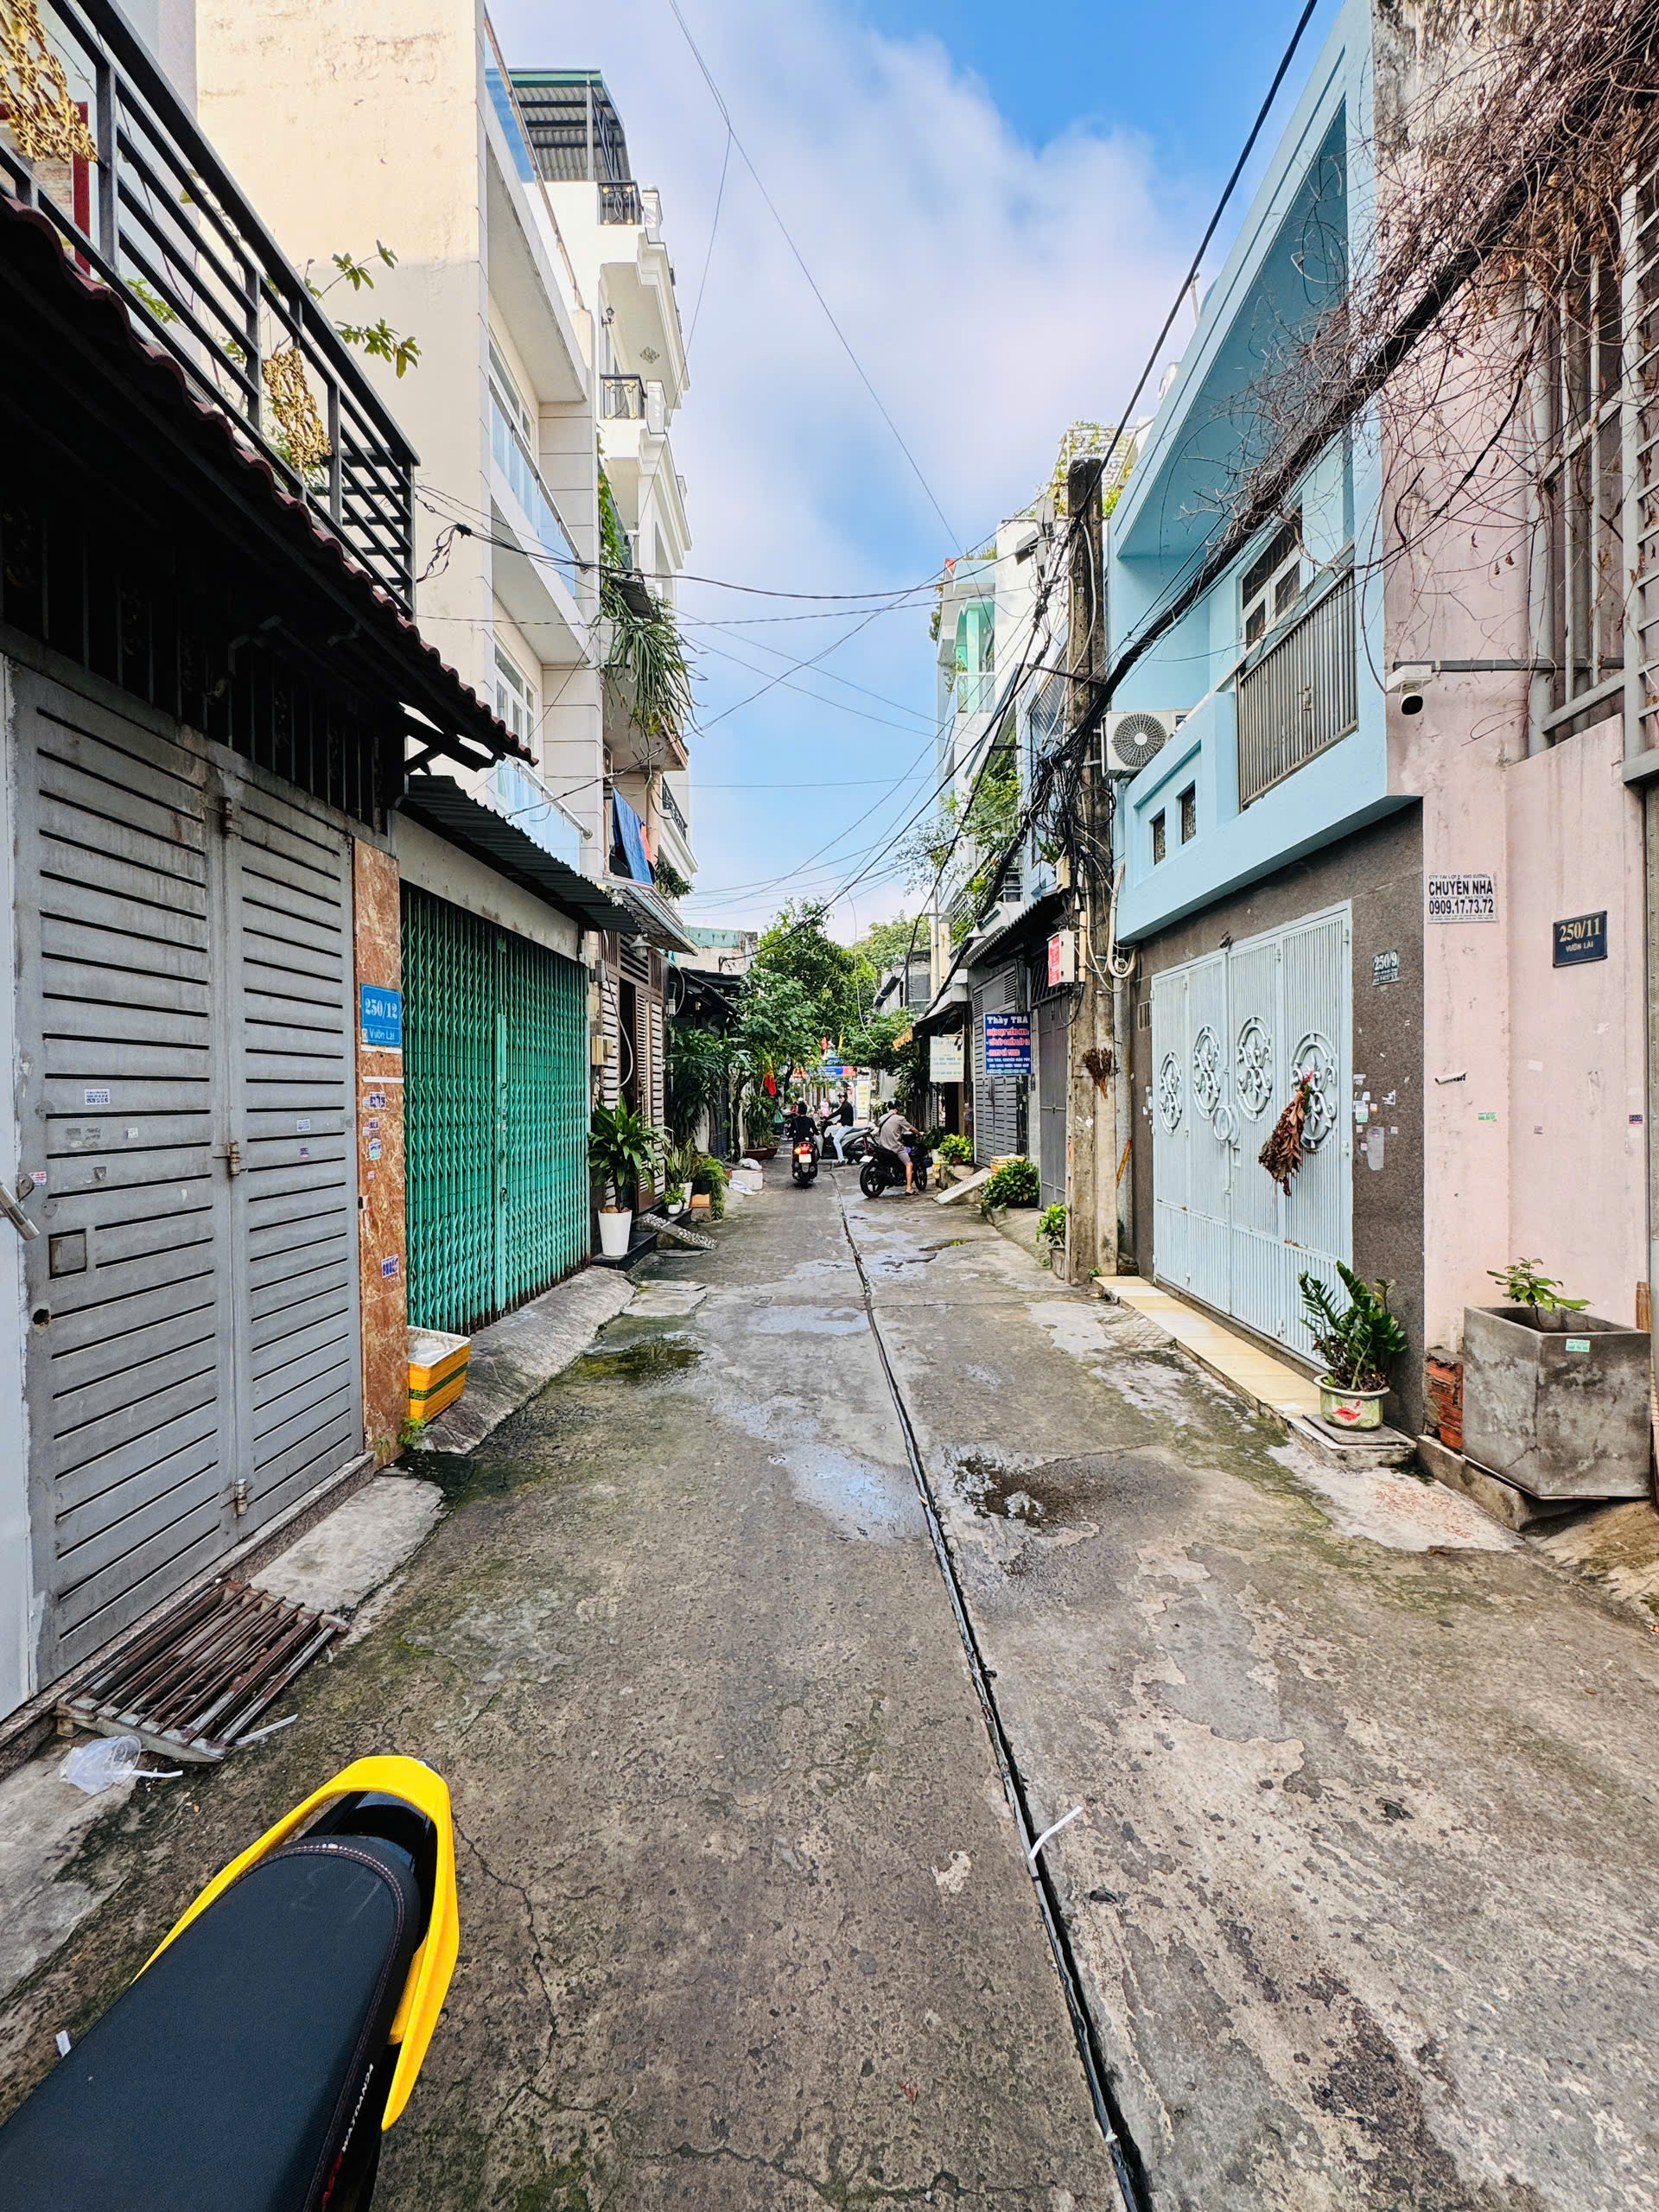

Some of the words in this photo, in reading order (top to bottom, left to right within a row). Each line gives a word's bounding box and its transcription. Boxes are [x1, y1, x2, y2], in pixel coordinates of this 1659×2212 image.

[1428, 899, 1494, 915] 0909.17.73.72
[1559, 918, 1601, 942] 250/11
[365, 997, 397, 1020] 250/12
